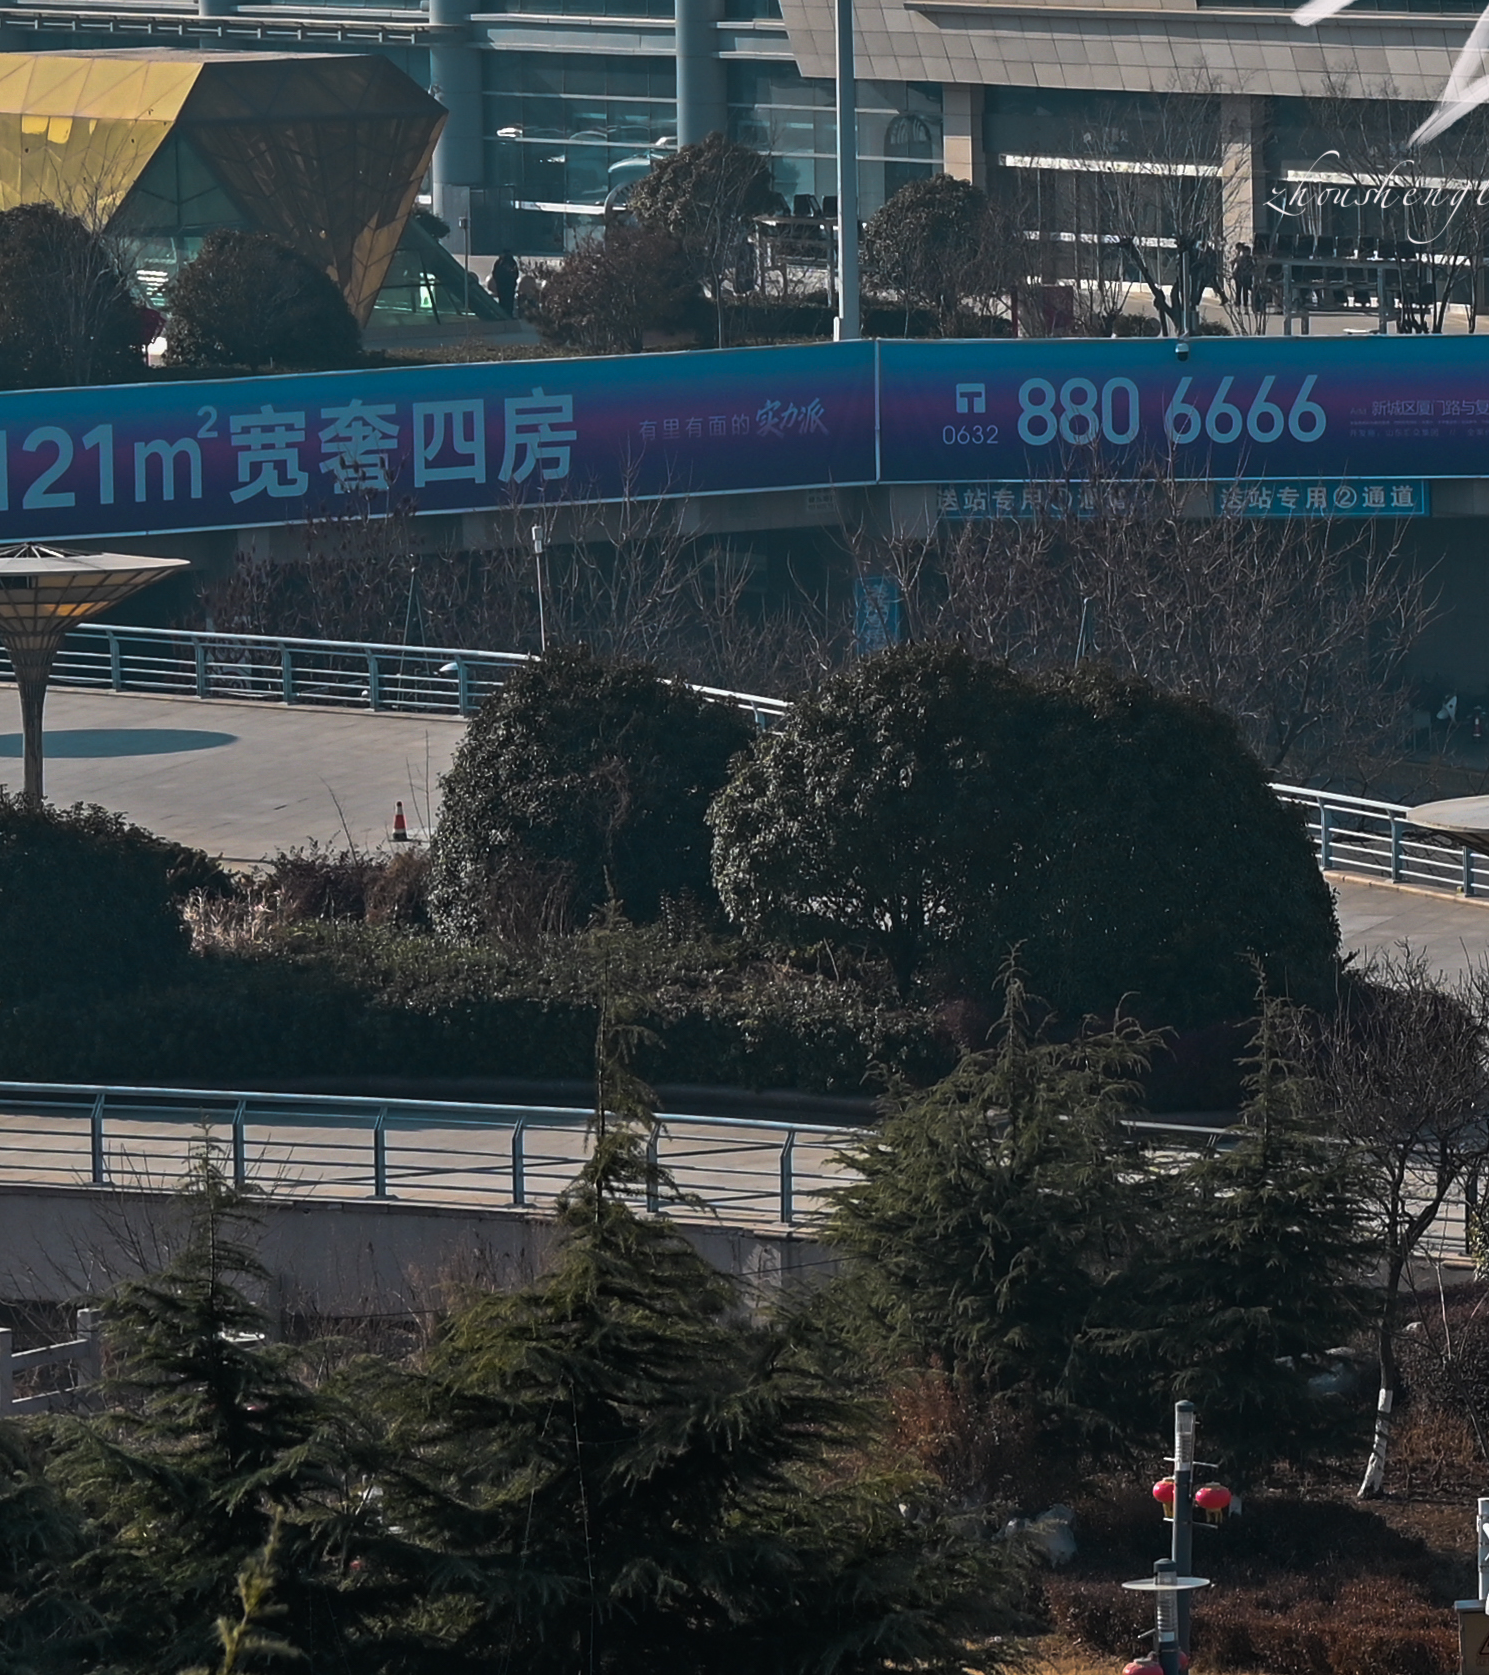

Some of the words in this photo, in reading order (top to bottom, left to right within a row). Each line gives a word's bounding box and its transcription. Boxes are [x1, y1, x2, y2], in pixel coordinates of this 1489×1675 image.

[1017, 376, 1140, 446] 880
[1164, 373, 1328, 444] 6666
[942, 424, 999, 445] 0632
